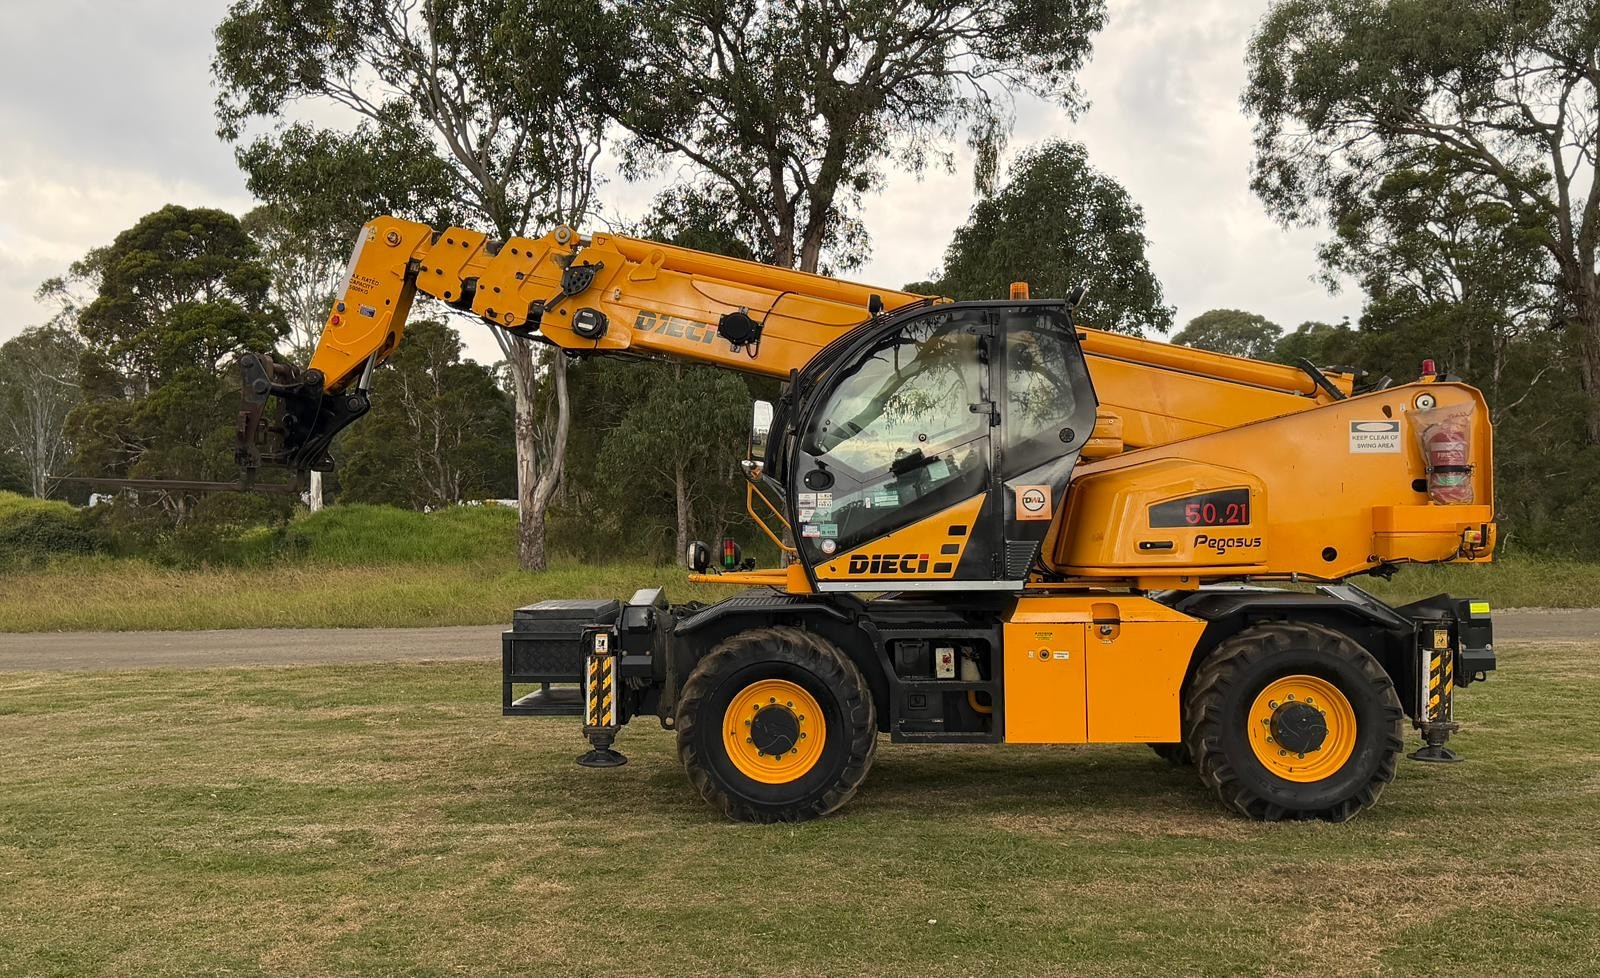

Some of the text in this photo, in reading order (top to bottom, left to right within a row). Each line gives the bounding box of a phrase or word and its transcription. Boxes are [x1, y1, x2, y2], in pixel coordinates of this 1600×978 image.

[633, 310, 718, 344] DIECI
[1185, 503, 1247, 524] 50.21
[1193, 534, 1262, 555] Pegasus
[848, 553, 930, 574] DIECI
